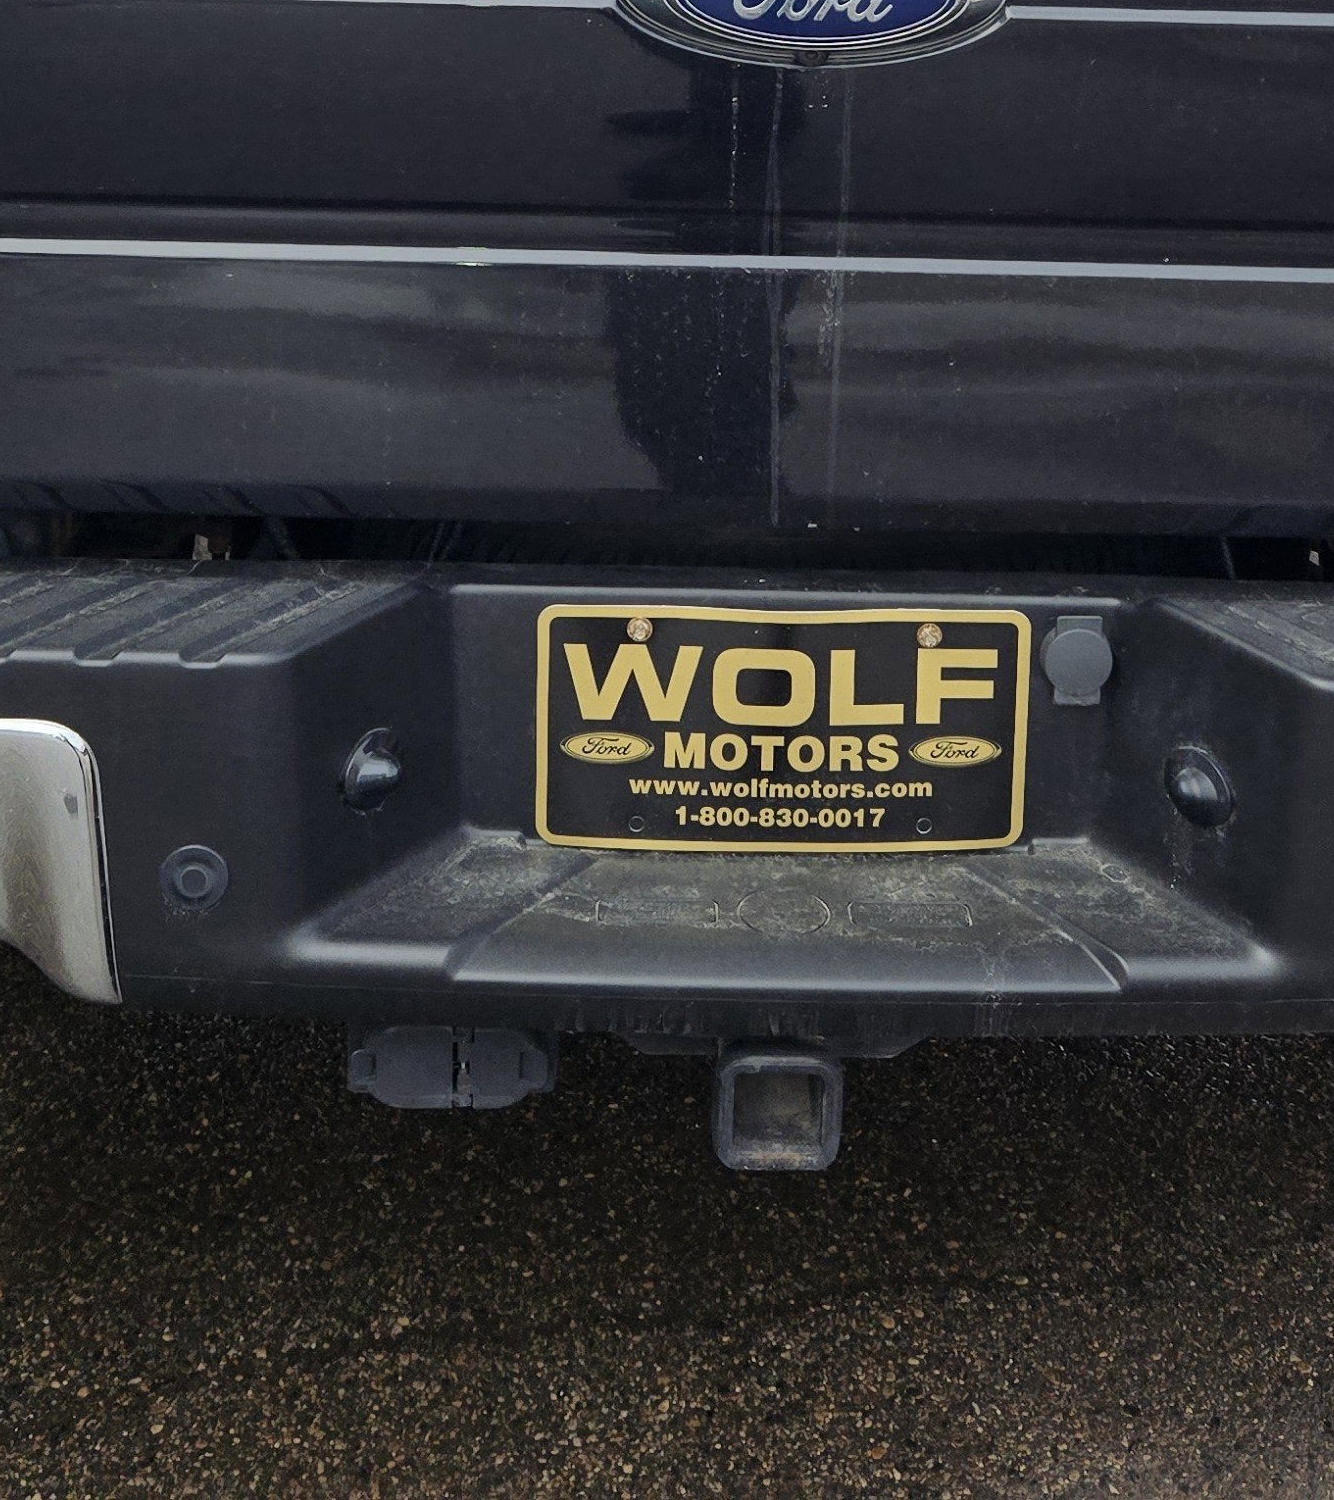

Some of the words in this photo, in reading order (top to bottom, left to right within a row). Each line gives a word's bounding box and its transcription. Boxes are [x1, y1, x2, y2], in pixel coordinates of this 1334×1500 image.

[563, 642, 999, 728] WOLF
[581, 737, 633, 757] Ford
[663, 731, 900, 773] MOTORS
[929, 739, 980, 761] Ford
[628, 776, 933, 799] www.wolfmotors.com
[675, 805, 886, 829] 1-800-830-0017
